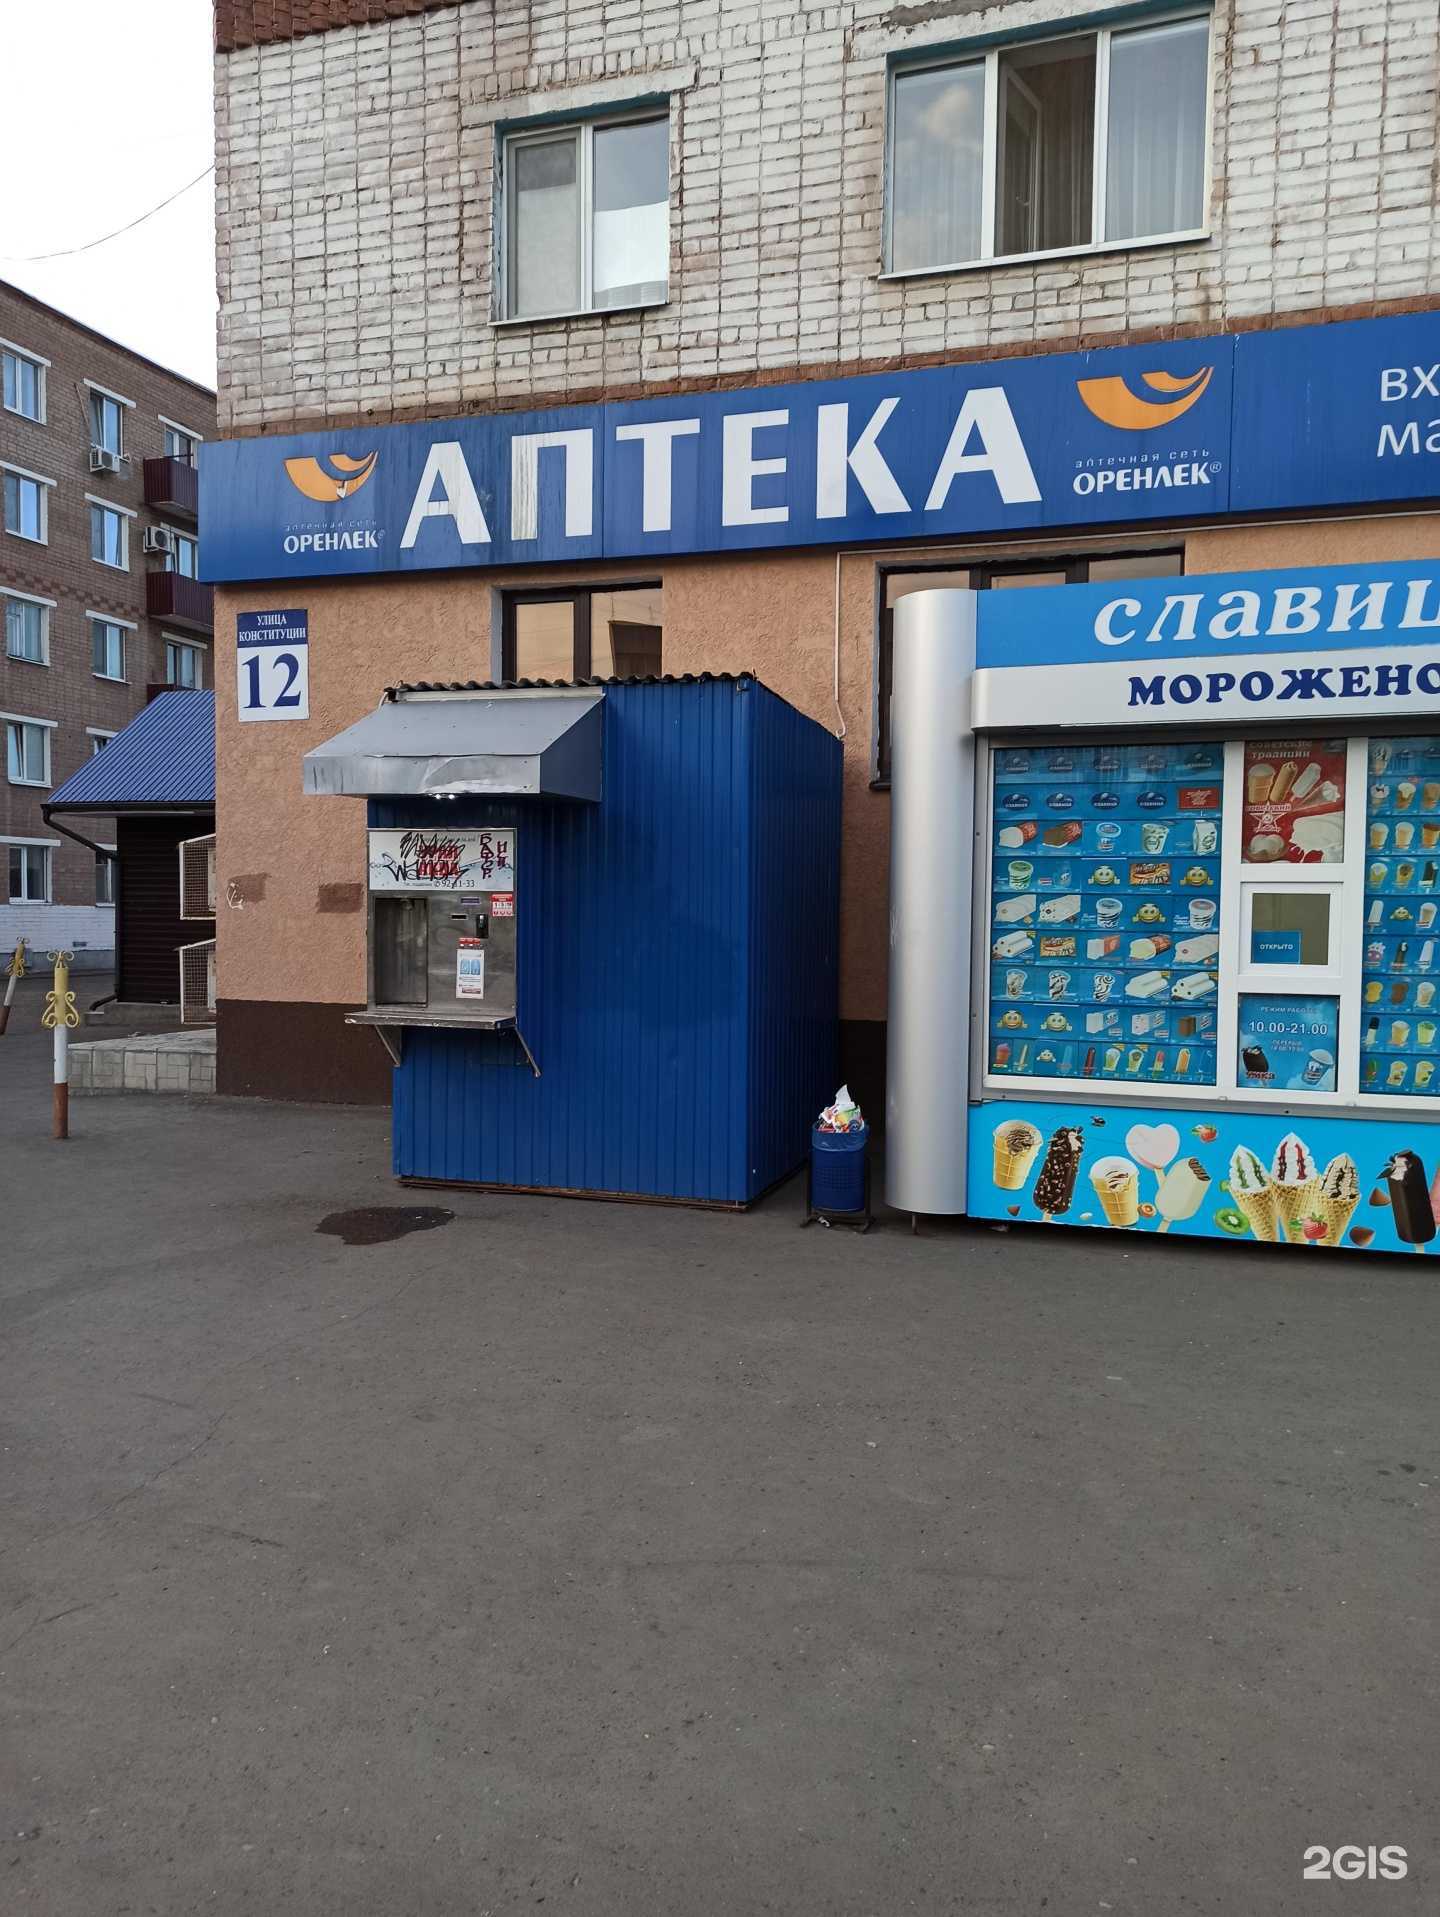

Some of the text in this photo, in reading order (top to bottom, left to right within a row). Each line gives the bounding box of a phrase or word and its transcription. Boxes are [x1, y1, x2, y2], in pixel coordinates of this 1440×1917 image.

[400, 386, 1043, 548] АПТЕКА
[1075, 448, 1209, 469] аптечная сеть
[257, 614, 287, 626] УЛИЦА
[239, 627, 307, 642] КОНСТИТУЦИИ
[241, 653, 302, 709] 12
[1127, 662, 1440, 706] МОРОЖЕНО
[1259, 943, 1294, 951] ОТКРЫТО
[1249, 1021, 1328, 1036] 10.00-21.00
